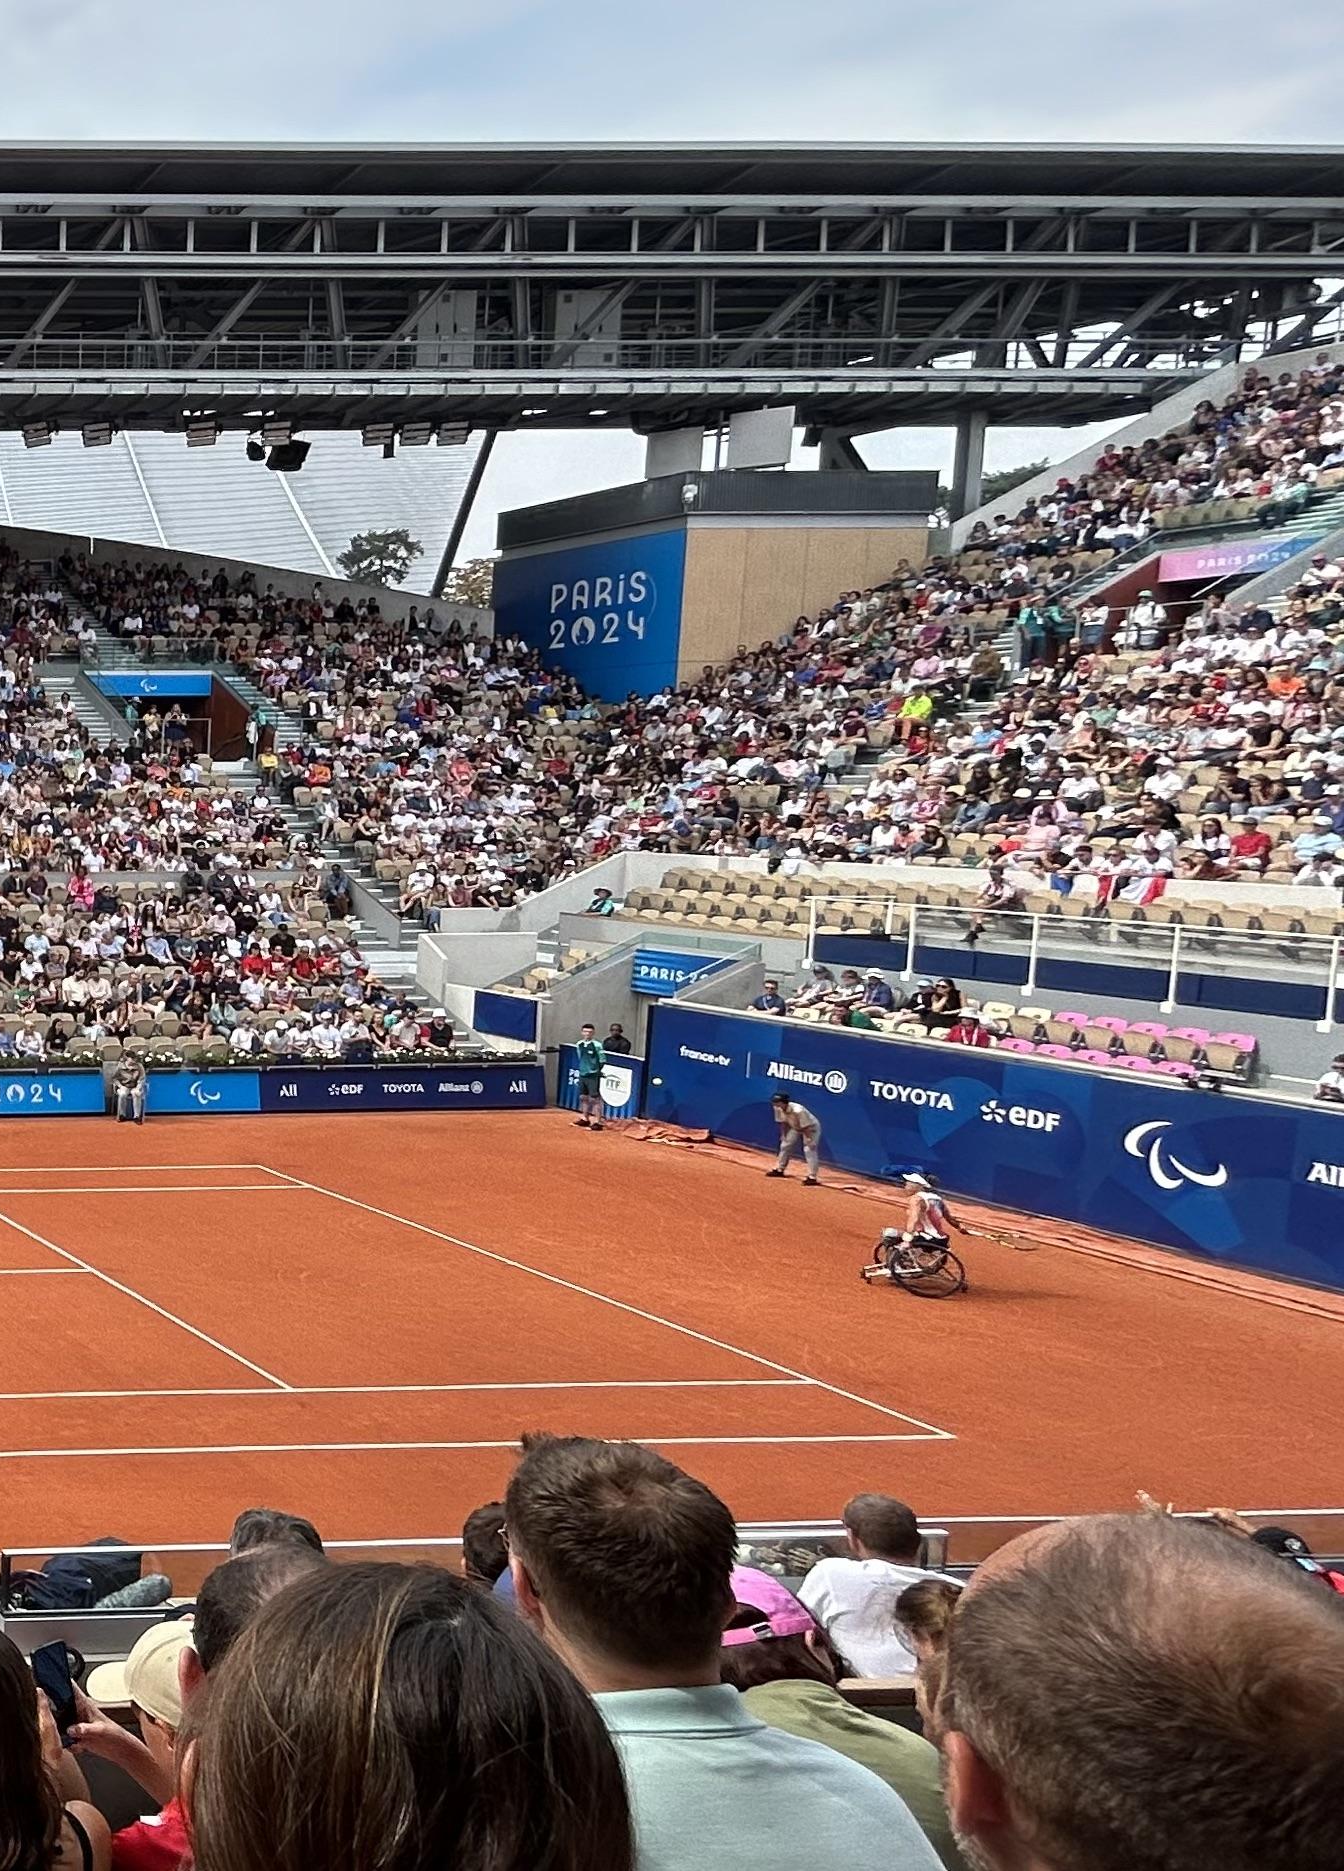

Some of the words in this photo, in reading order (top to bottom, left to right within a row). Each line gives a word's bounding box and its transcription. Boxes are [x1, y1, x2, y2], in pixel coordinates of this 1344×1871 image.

[548, 609, 645, 650] 2024
[766, 1061, 823, 1087] Allianz
[381, 1083, 425, 1094] TOYOTA
[437, 1082, 470, 1094] Allianz
[870, 1080, 954, 1111] TOYOTA
